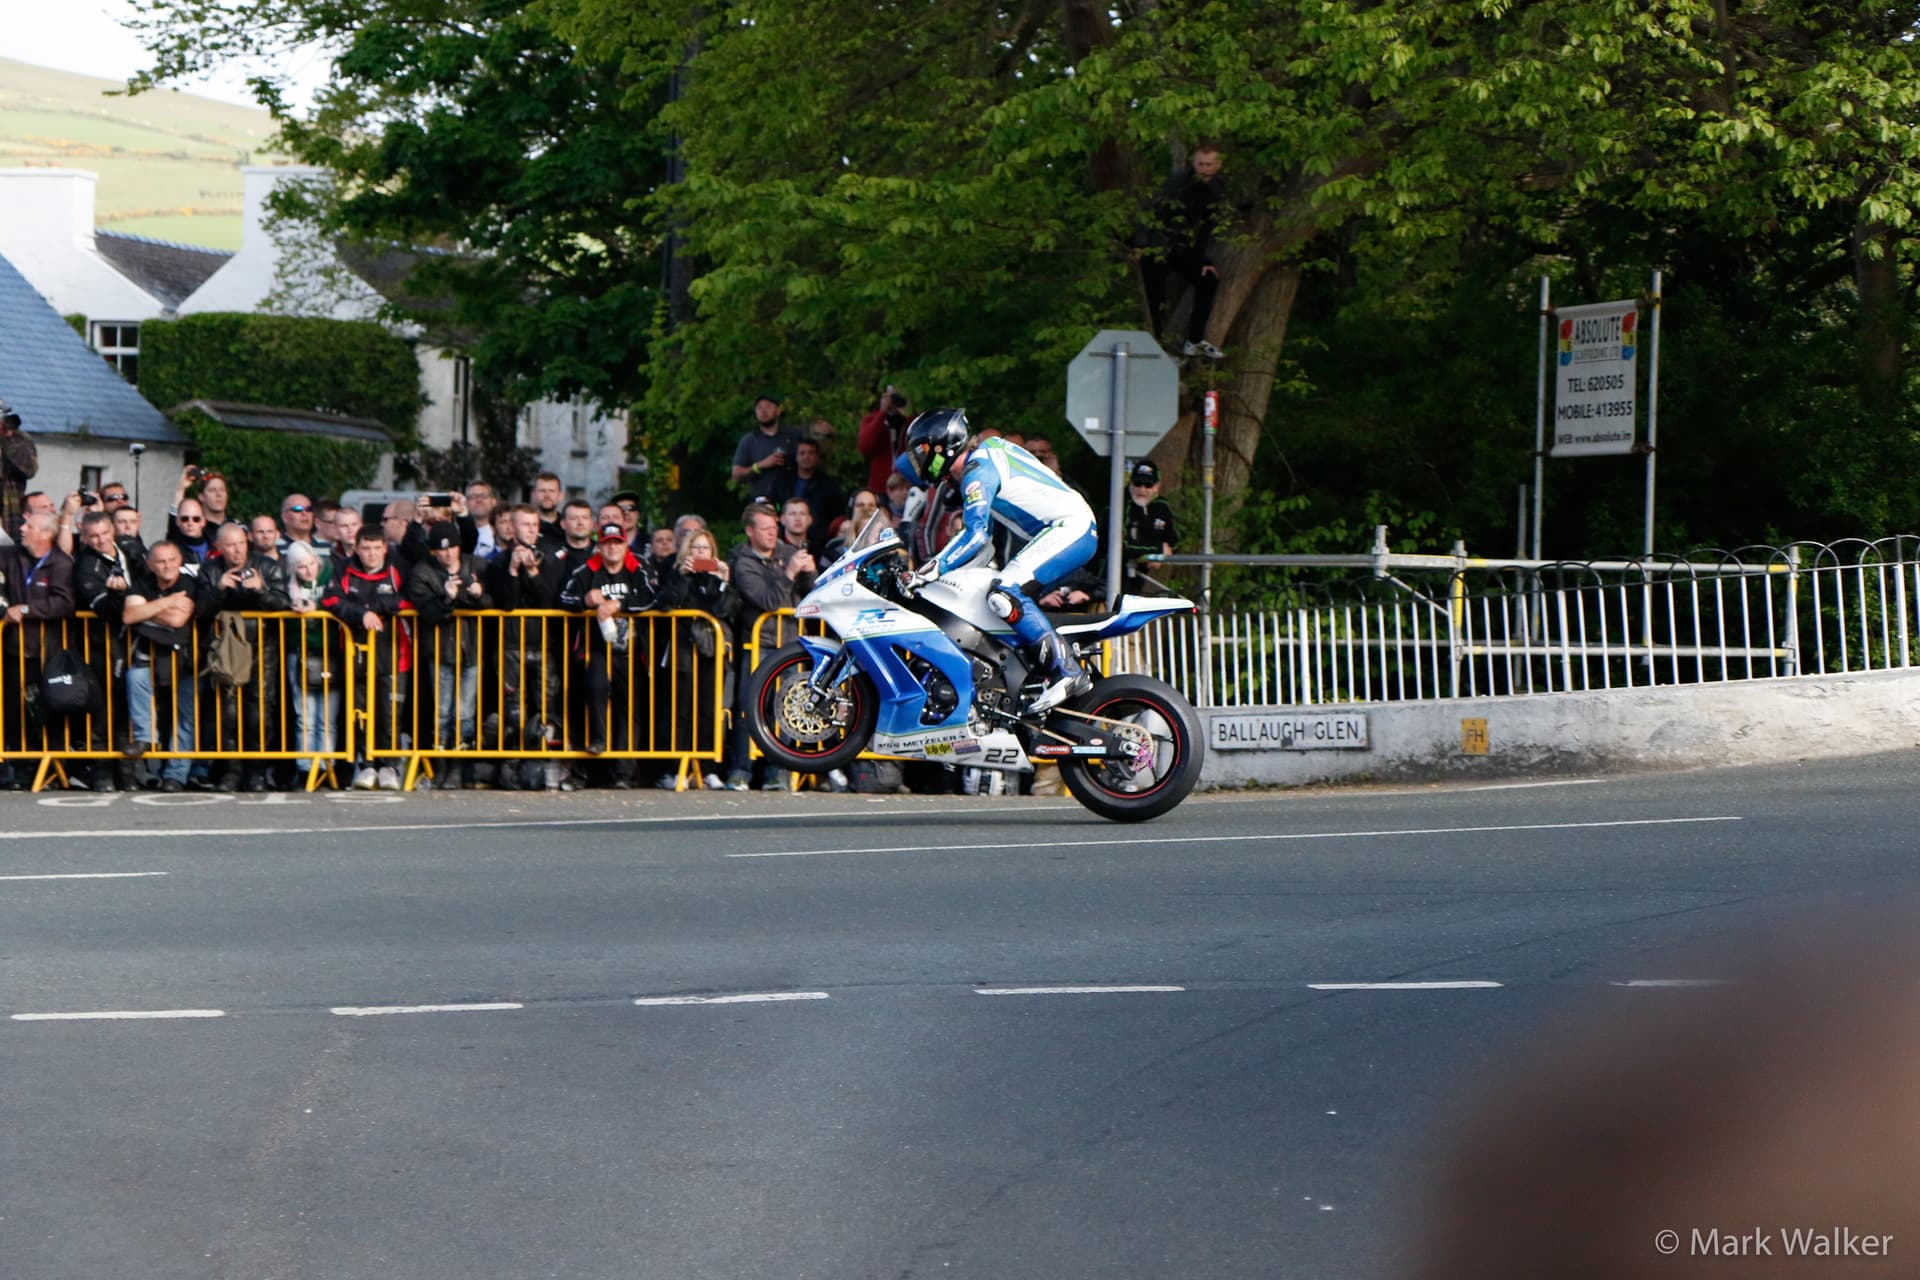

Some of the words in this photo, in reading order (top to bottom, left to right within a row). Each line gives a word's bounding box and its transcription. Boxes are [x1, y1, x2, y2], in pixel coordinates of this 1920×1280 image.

[1574, 316, 1621, 345] ABSOLUTE
[1568, 378, 1586, 393] TEL:
[1587, 374, 1624, 392] 620505
[1558, 403, 1594, 421] MOBILE:
[1595, 400, 1633, 418] 413955
[1218, 721, 1305, 742] BALLAUGH
[1314, 720, 1359, 740] GLEN
[1467, 729, 1485, 743] FH
[903, 735, 957, 748] METZELER
[984, 748, 1019, 764] 22
